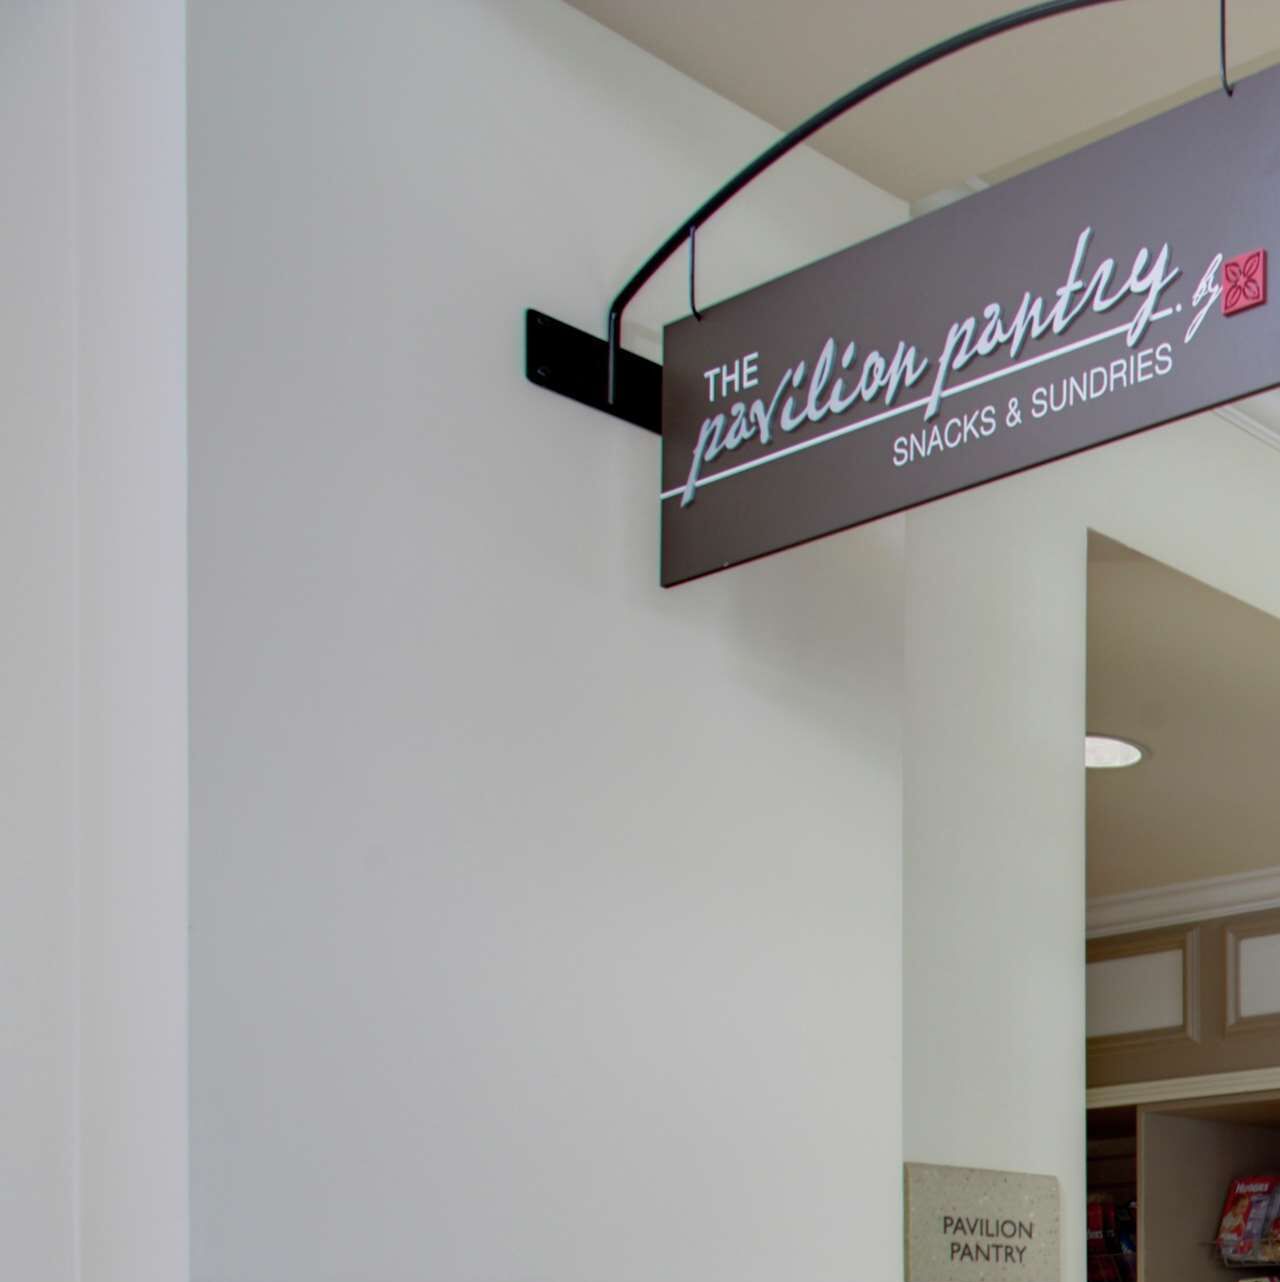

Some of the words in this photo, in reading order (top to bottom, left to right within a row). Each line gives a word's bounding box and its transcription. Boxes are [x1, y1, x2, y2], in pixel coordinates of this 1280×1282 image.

[704, 352, 759, 402] THE
[681, 337, 929, 508] pavilion
[892, 405, 997, 467] SNACKS
[1005, 397, 1023, 428] &
[1031, 342, 1173, 419] SUNDRIES
[943, 1216, 1033, 1239] PAVILION
[951, 1242, 1027, 1263] PANTRY
